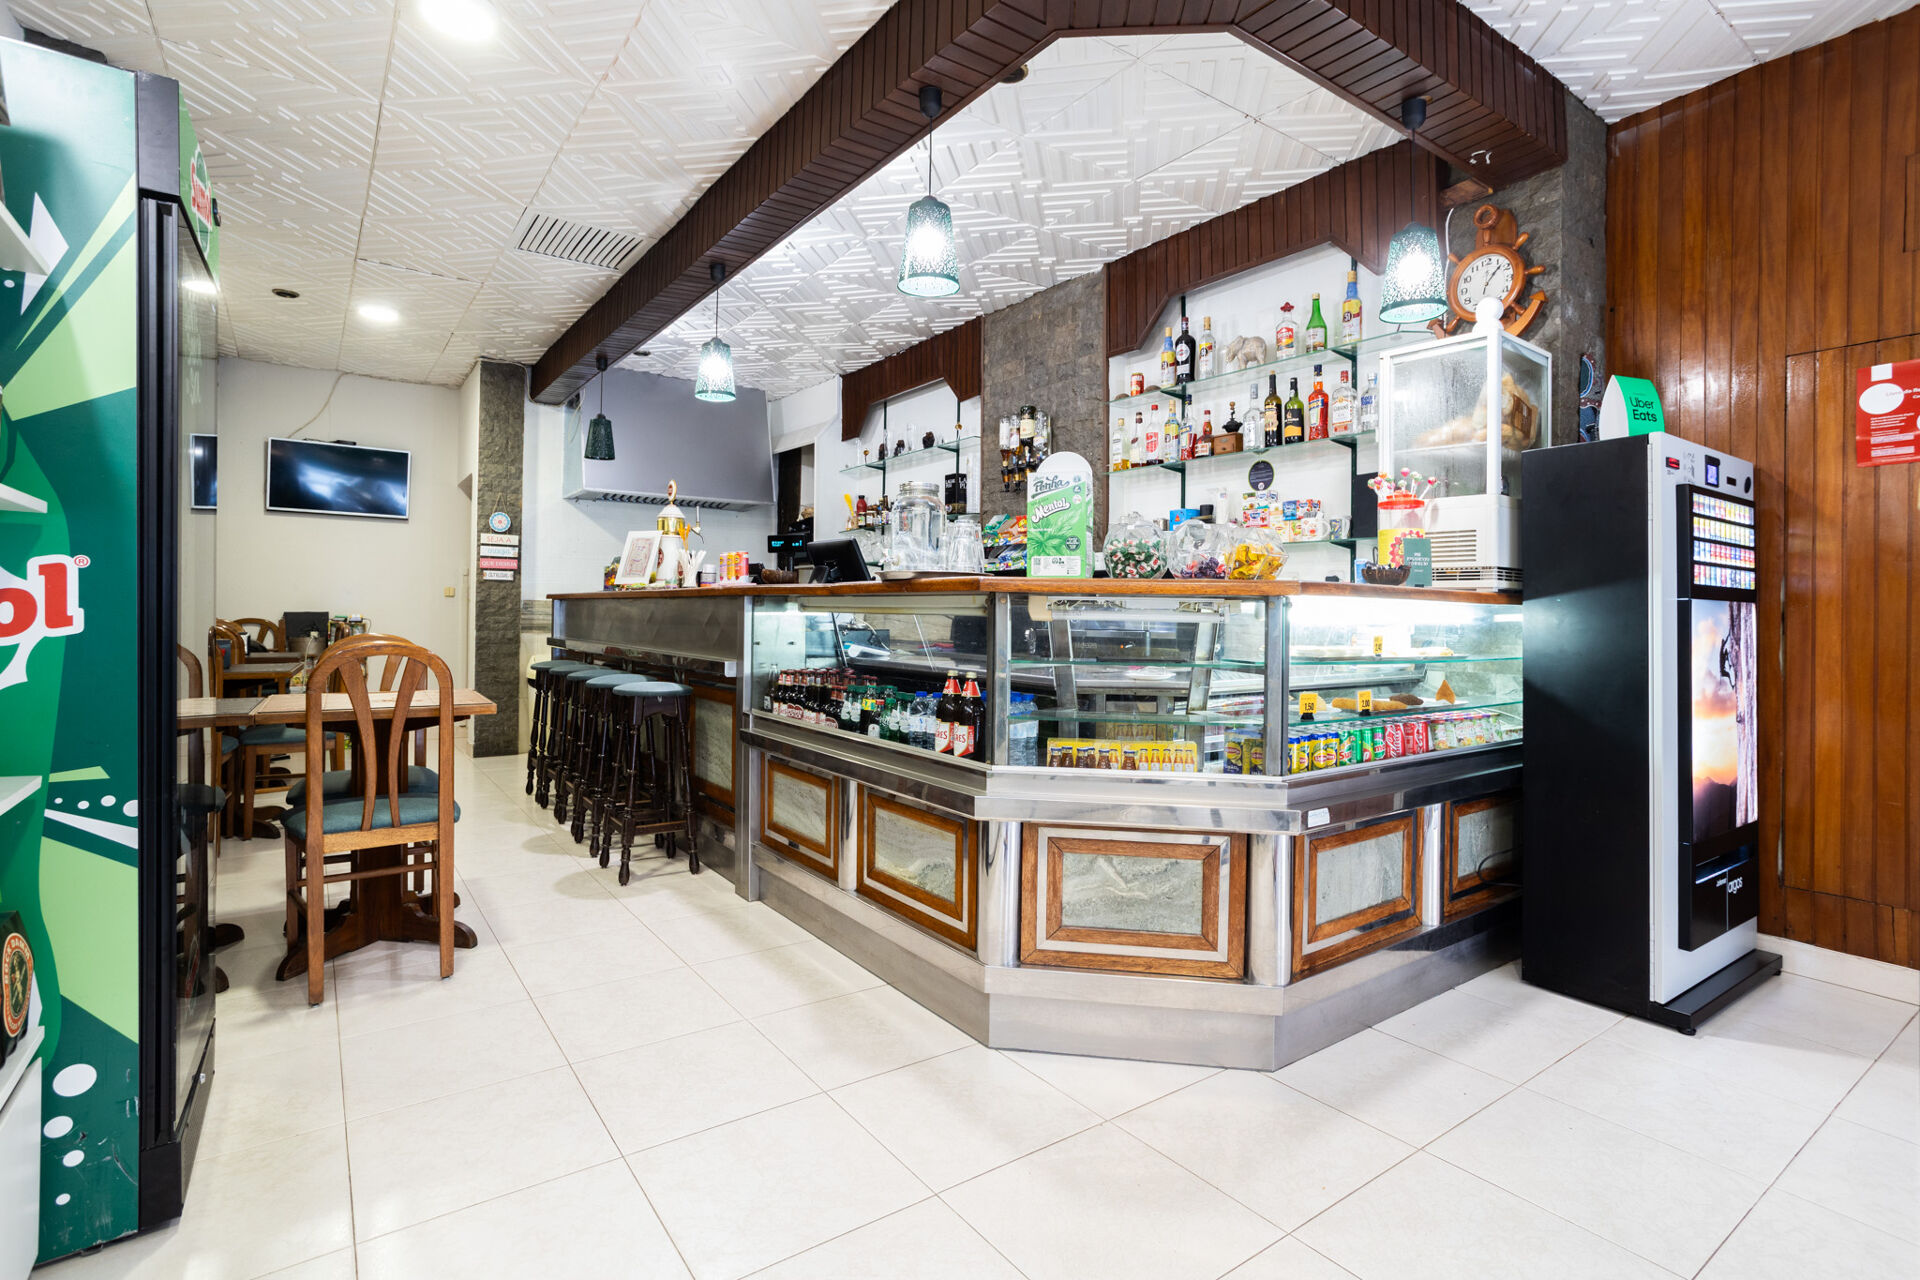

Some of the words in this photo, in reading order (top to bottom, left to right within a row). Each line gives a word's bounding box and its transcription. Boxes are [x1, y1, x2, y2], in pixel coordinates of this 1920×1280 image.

[1463, 275, 1472, 284] 10
[1629, 396, 1654, 409] Uber
[1632, 409, 1658, 422] Eats
[1031, 497, 1071, 523] Mentol
[487, 535, 504, 543] SEJA
